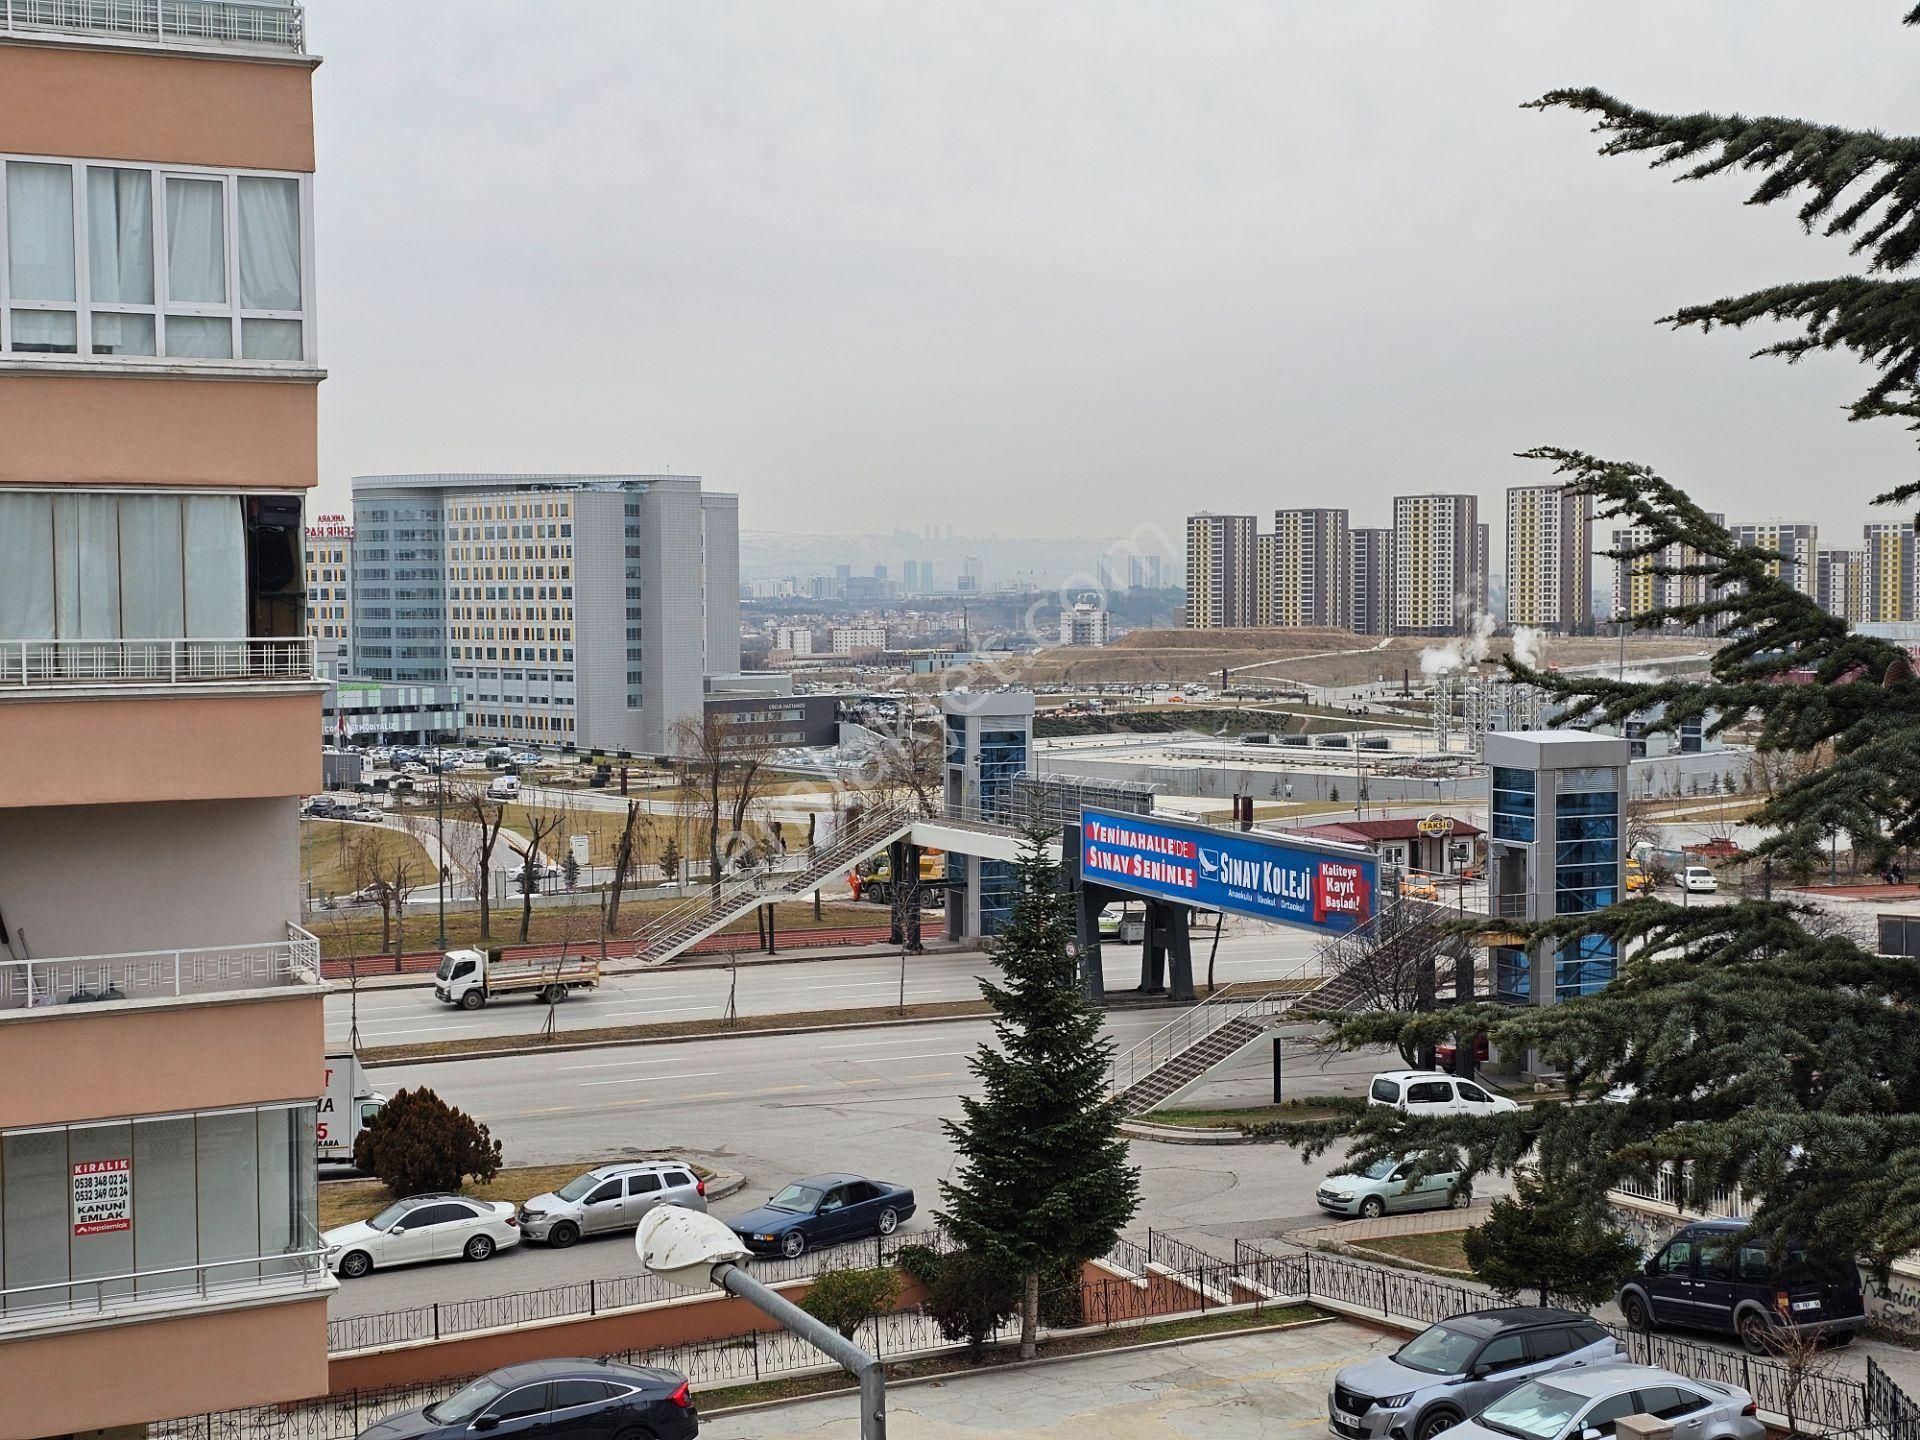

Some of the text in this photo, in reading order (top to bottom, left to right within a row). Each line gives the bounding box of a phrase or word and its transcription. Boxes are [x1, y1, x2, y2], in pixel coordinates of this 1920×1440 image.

[1091, 821, 1188, 858] YENİMAHALLE'DE
[1089, 845, 1193, 888] SINAV SENİNLE
[1322, 863, 1357, 880] Kaliteye
[1220, 851, 1311, 901] SINAV KOLEJİ
[1326, 877, 1355, 896] Kayıt
[1227, 888, 1253, 902] Anaokulu
[1280, 899, 1306, 913] Ortaokul
[1325, 895, 1360, 912] Başladı!
[317, 1122, 328, 1140] 5
[317, 1139, 339, 1147] KARA
[74, 1159, 128, 1174] KIRALIK
[74, 1173, 128, 1189] 0538 348 02 24
[74, 1186, 128, 1202] 0532 349 02 24
[77, 1200, 126, 1214] KANUNİ
[80, 1211, 124, 1223] EMLAK
[87, 1222, 128, 1232] hepsiemlak
